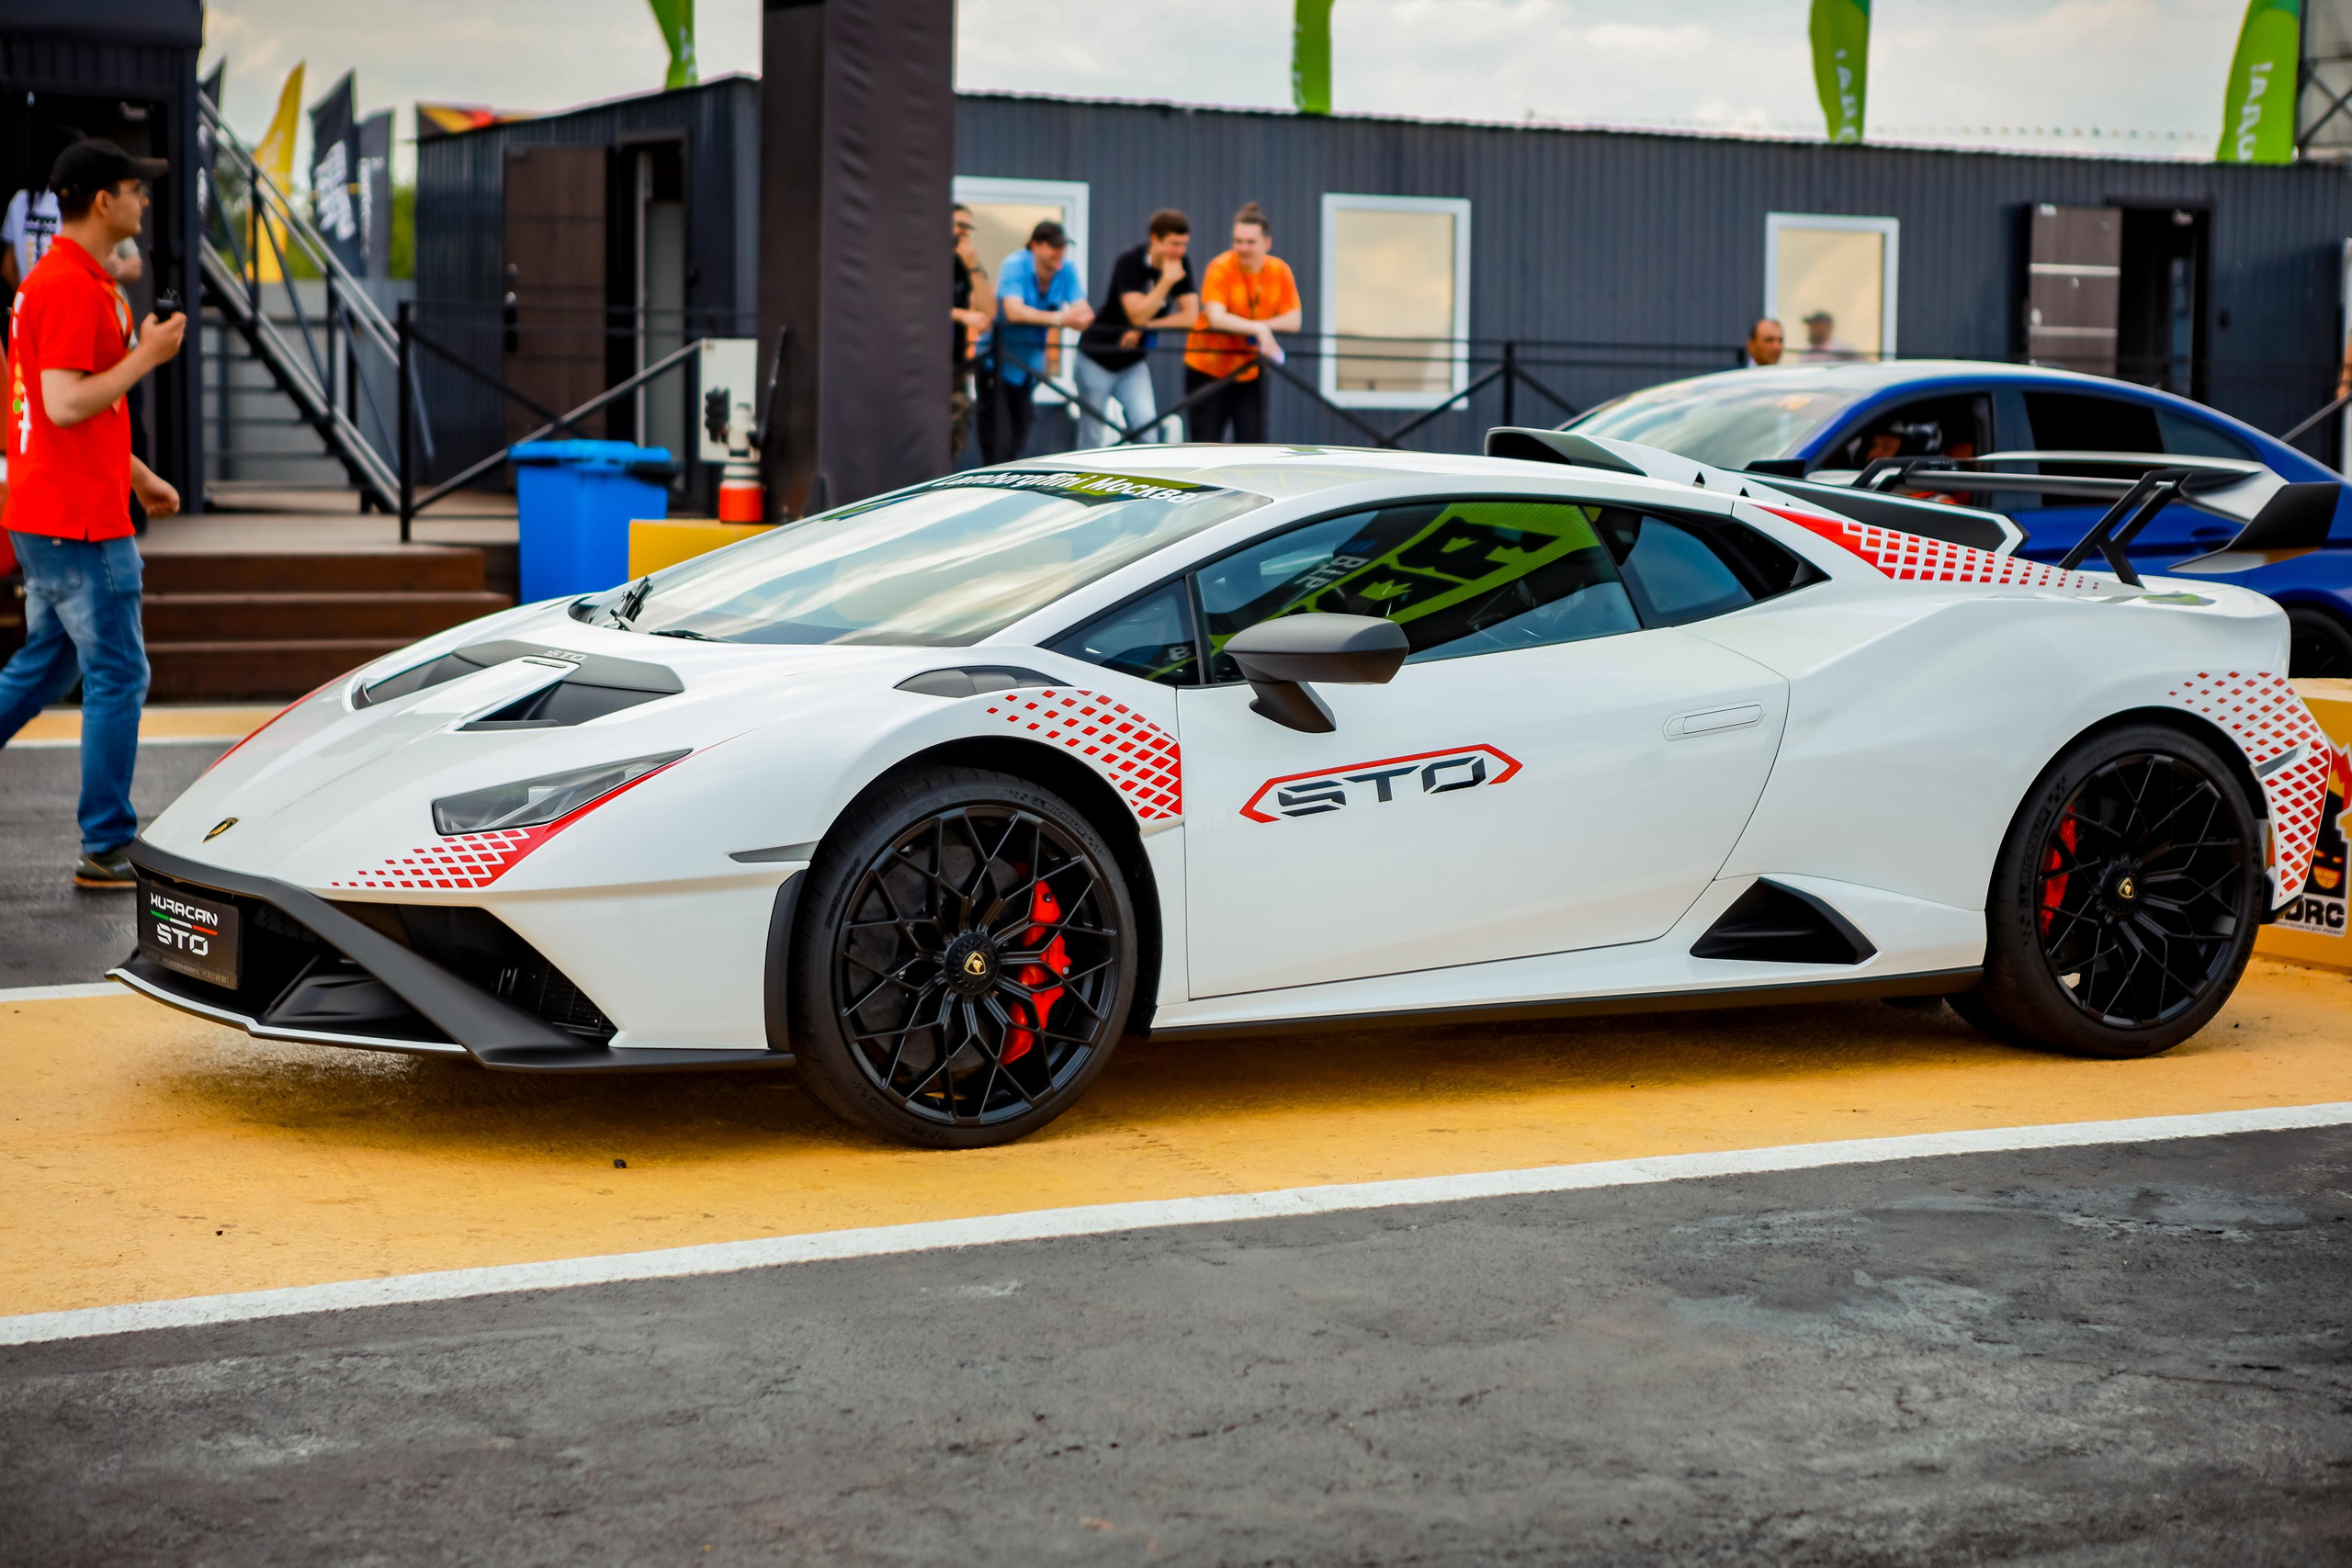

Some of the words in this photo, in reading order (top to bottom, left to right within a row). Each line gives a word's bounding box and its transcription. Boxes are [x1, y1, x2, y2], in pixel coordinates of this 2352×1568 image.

[1081, 474, 1199, 503] Москва
[543, 649, 588, 661] STO
[1277, 755, 1487, 817] STO
[150, 891, 219, 927] HURACAN
[156, 922, 209, 956] STO
